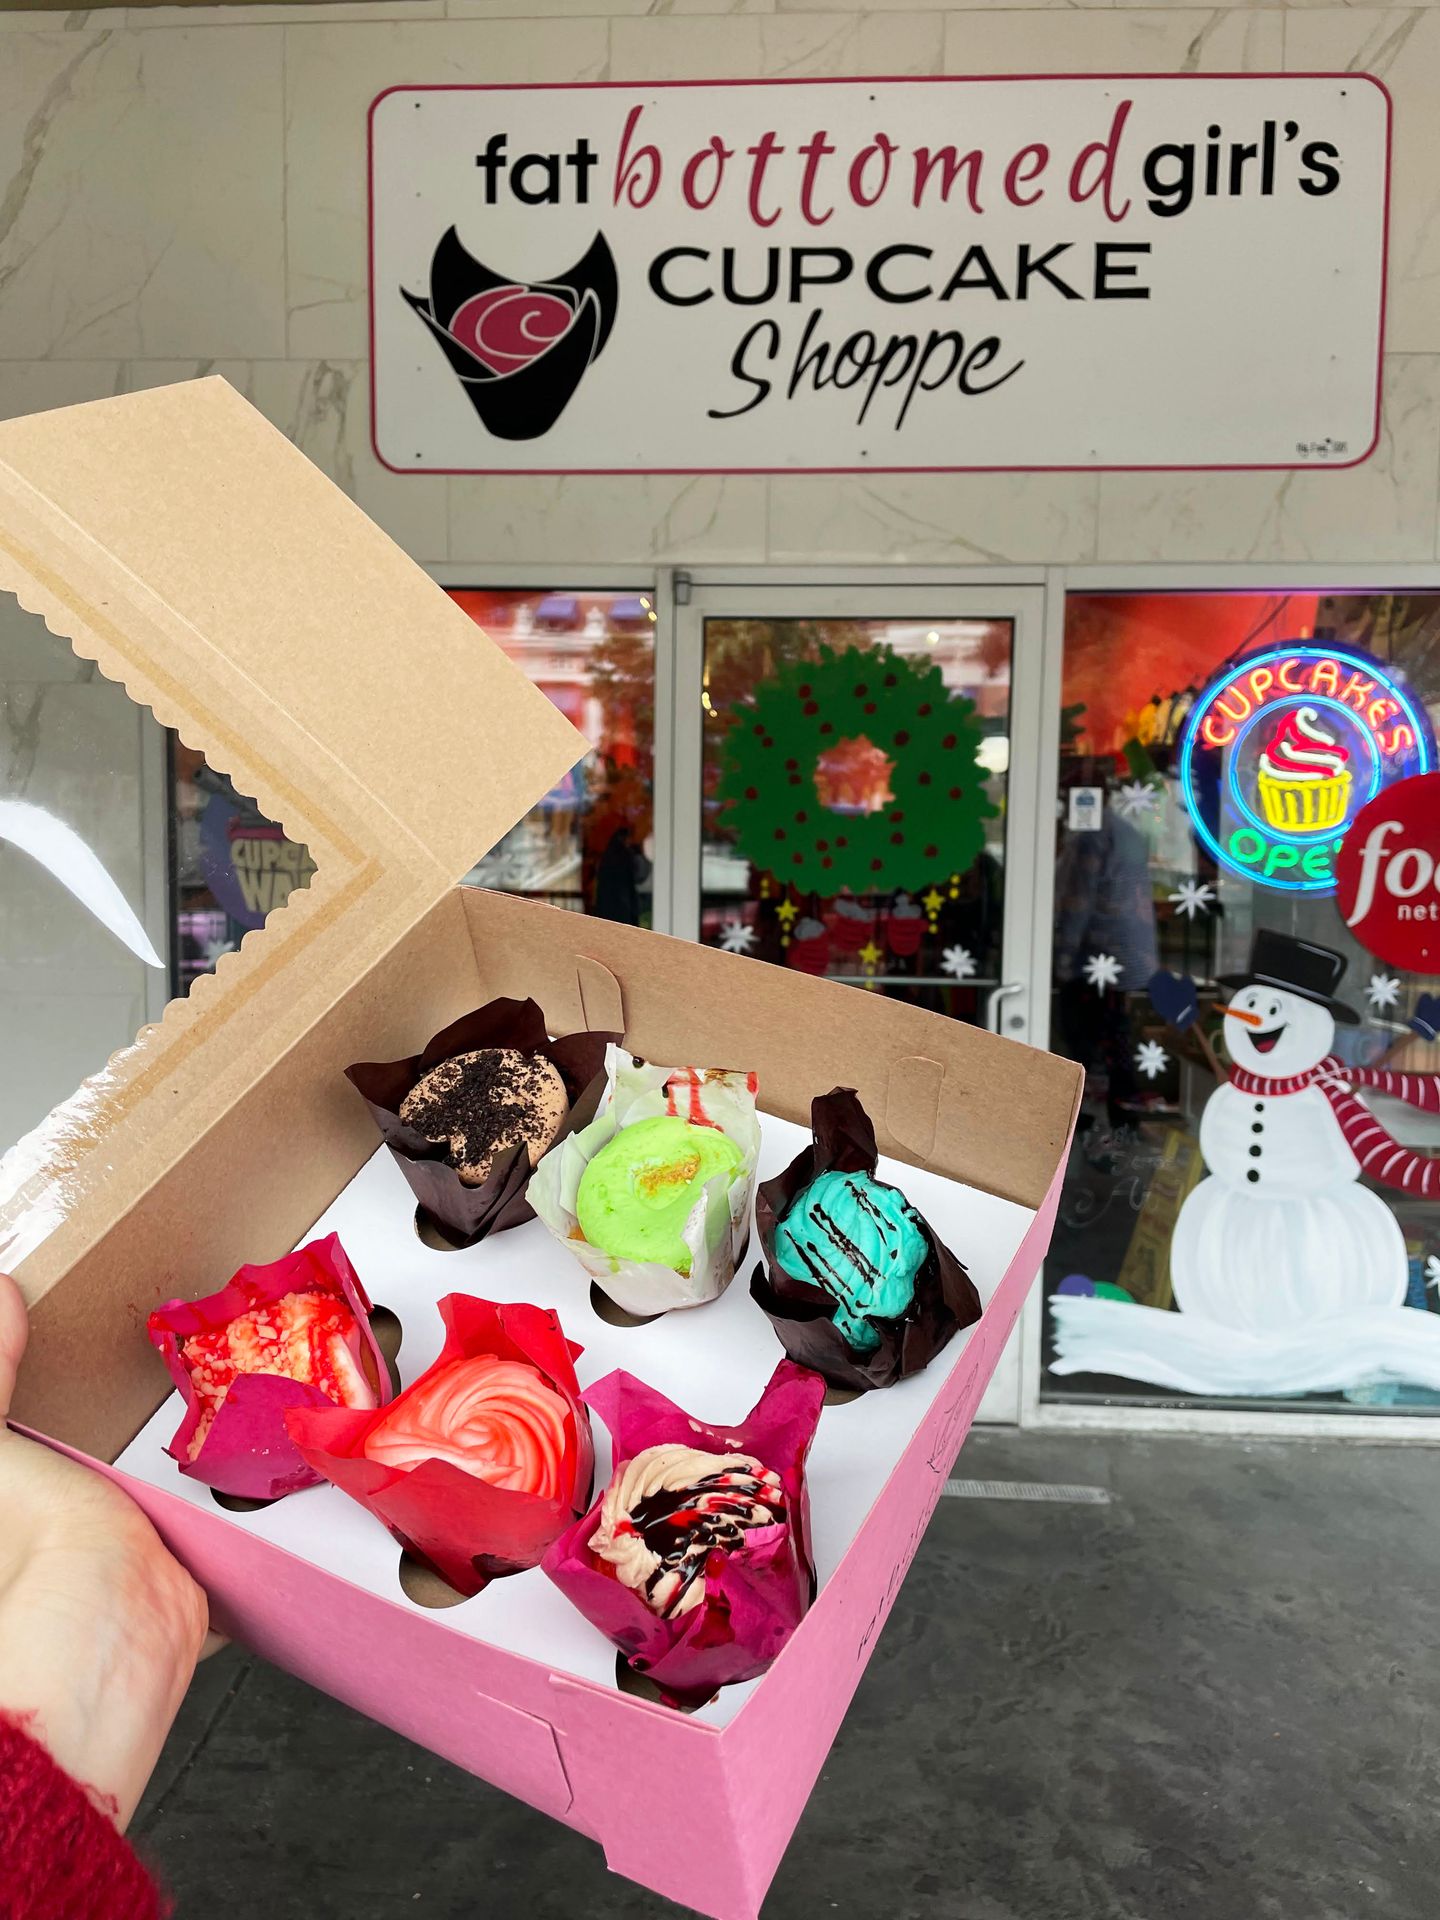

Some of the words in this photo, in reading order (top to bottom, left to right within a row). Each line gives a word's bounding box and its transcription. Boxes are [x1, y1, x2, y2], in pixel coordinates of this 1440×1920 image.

[476, 133, 598, 205] fat
[612, 99, 1133, 228] bottomed
[1142, 120, 1341, 218] girl's
[647, 242, 1152, 306] CUPCAKE
[707, 307, 1025, 431] Shoppe
[1202, 658, 1414, 756] CUPCAKES
[1228, 827, 1344, 877] OPE
[1346, 820, 1440, 928] fo
